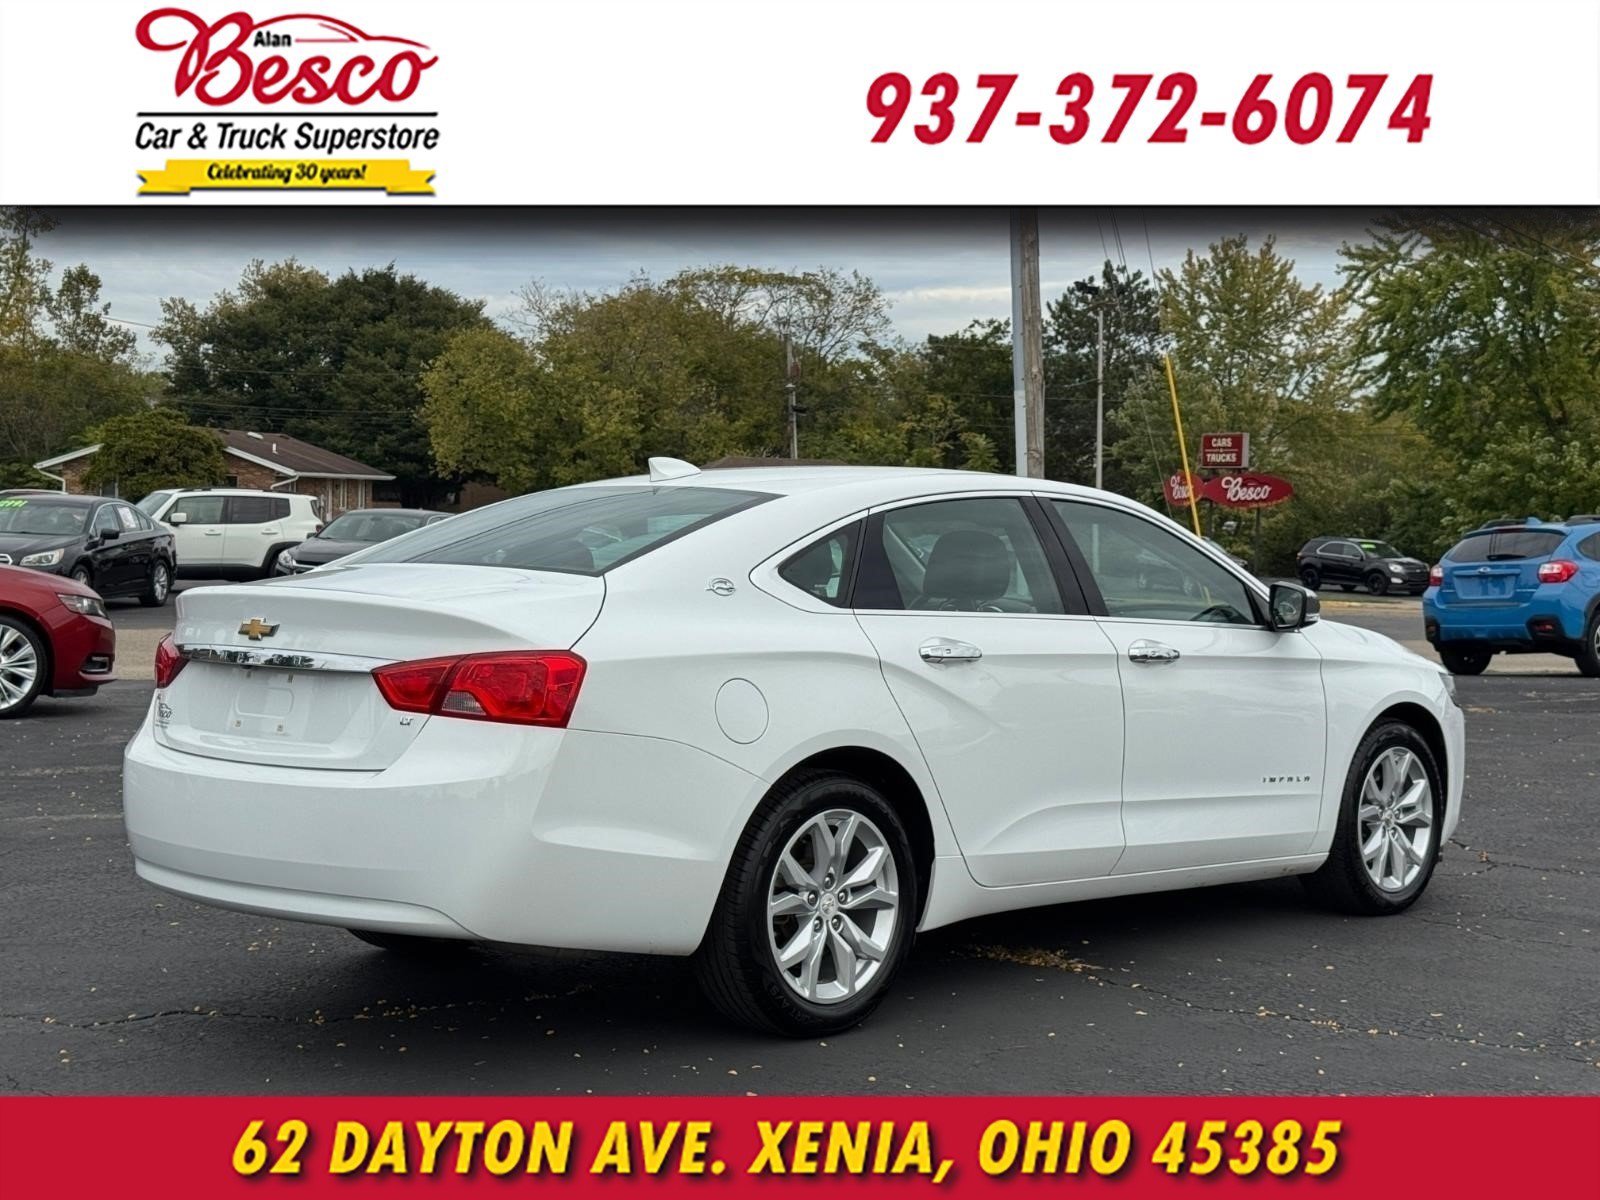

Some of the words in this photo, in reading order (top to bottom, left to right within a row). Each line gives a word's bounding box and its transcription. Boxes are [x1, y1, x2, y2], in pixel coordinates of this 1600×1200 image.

[1211, 437, 1233, 448] CARS
[1206, 453, 1237, 463] TRUCKS
[1221, 476, 1272, 501] Besco
[1262, 775, 1311, 784] IMPALA
